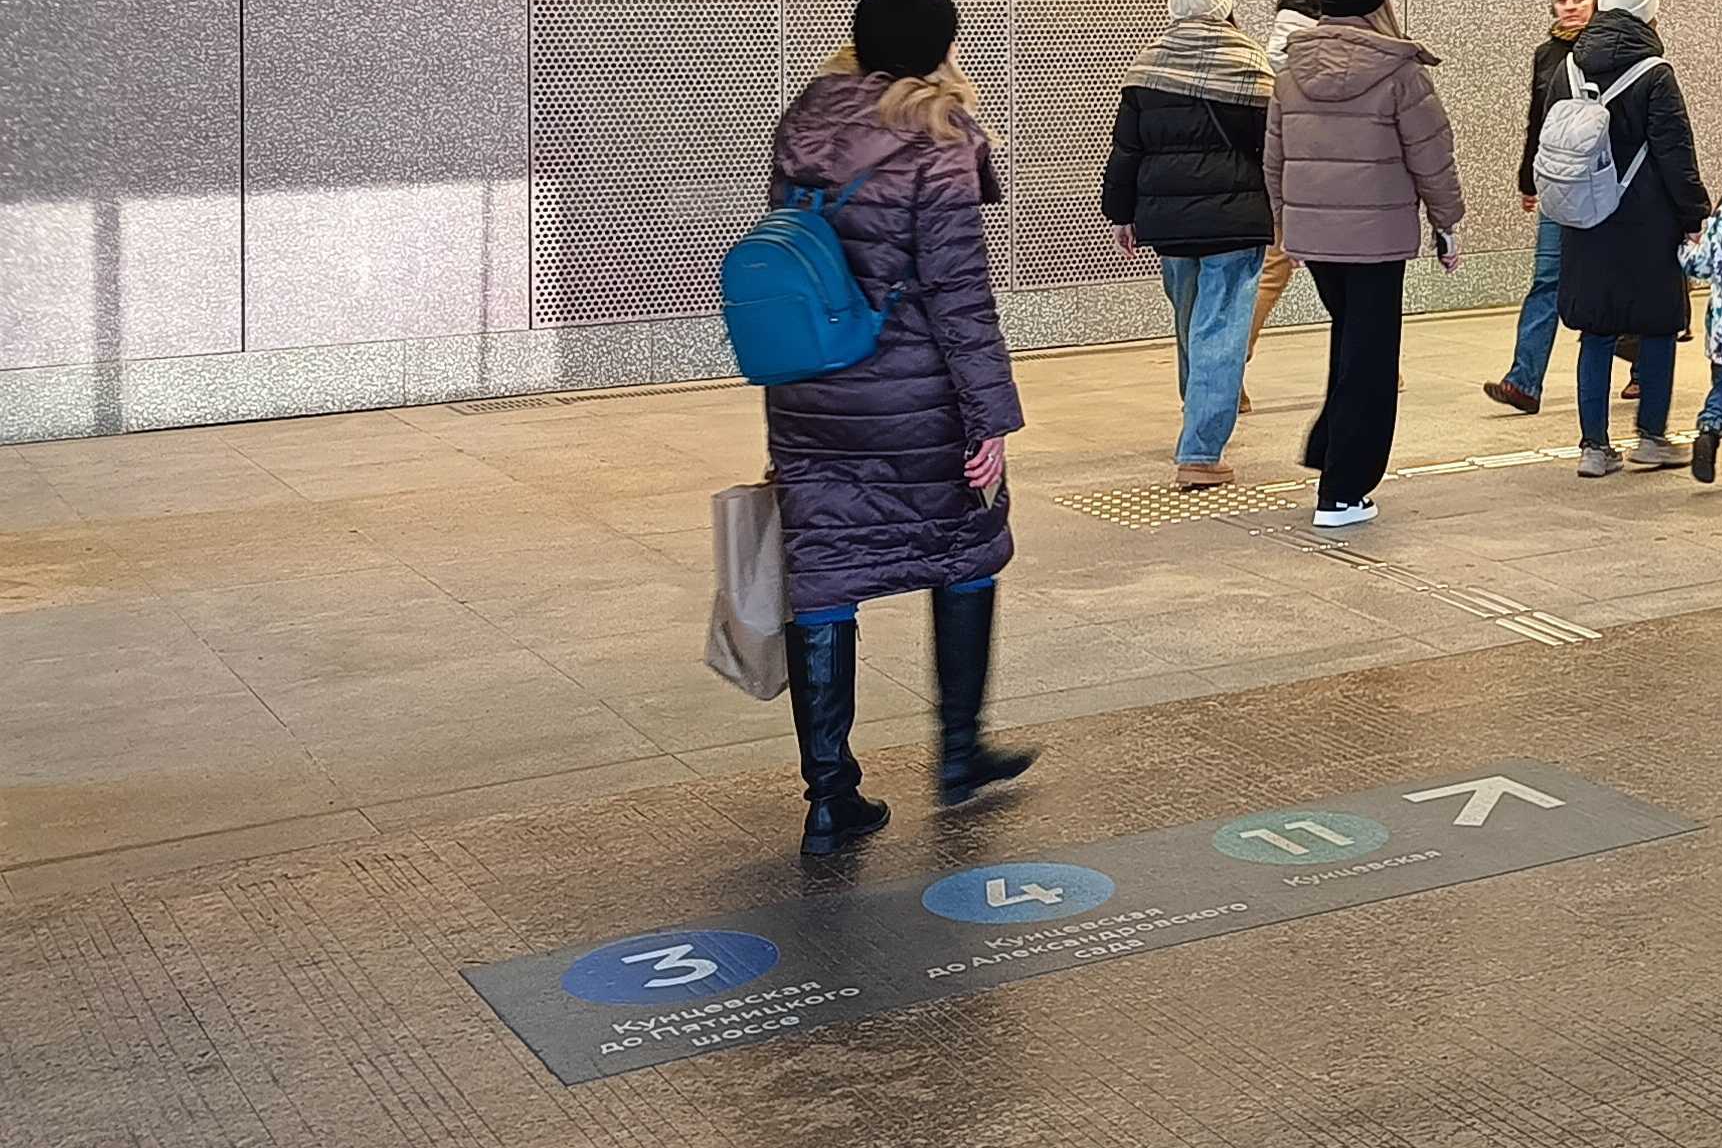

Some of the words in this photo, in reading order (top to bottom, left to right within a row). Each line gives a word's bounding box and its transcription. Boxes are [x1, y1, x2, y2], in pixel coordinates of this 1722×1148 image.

[1238, 820, 1355, 856] 11
[1282, 849, 1442, 888] Кунцевская
[985, 877, 1064, 908] 4
[926, 962, 967, 979] до
[972, 901, 1249, 968] Александровского
[984, 907, 1165, 950] Кунцевская
[1073, 937, 1145, 960] сада
[620, 943, 719, 988] 3
[600, 1036, 643, 1055] до
[648, 986, 861, 1041] Пятницкого
[611, 980, 822, 1036] Кунцевская
[690, 1015, 801, 1048] шоссе
